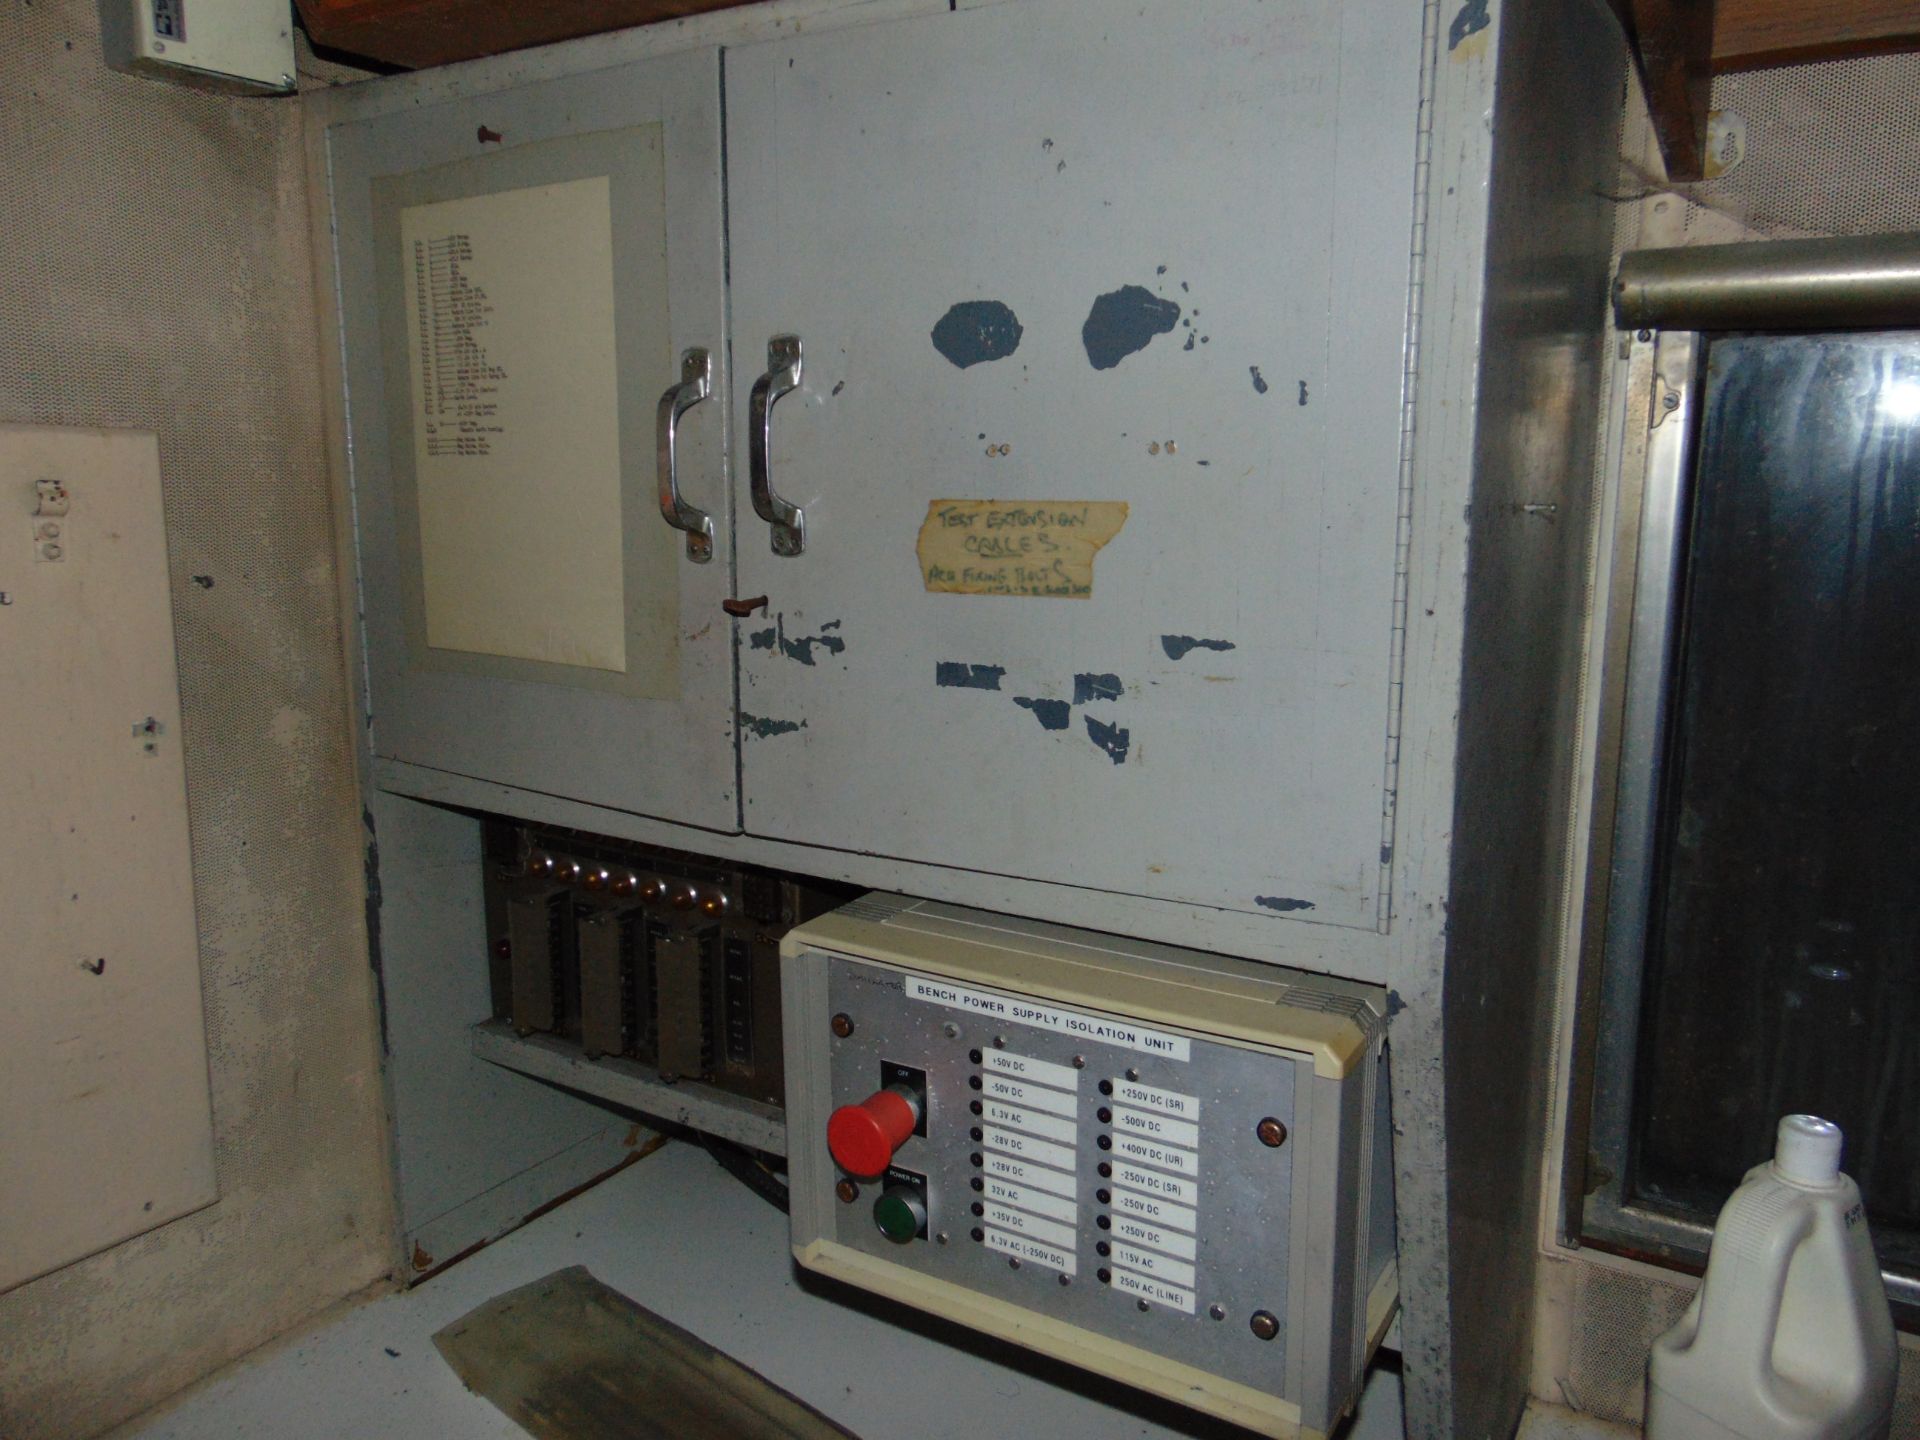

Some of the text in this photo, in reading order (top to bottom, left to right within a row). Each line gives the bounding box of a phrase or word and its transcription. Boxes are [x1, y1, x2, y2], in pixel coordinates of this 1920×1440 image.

[938, 507, 1088, 529] TEST EXTENSION
[918, 984, 1174, 1052] BENCH POWER SUPPLY ISOLATION UNIT
[993, 1058, 1024, 1071] +50V DC
[992, 1084, 1023, 1097] -50V DC
[1122, 1088, 1183, 1111] +250V DC (SR)
[991, 1108, 1022, 1123] 6.3V AC
[1121, 1117, 1160, 1131] -500V DC
[992, 1136, 1022, 1149] -28V DC
[1121, 1143, 1183, 1167] +400V DC (UR)
[992, 1162, 1023, 1176] +28V DC
[911, 1176, 921, 1185] ON
[1121, 1172, 1181, 1196] -250V DC (SR)
[991, 1186, 1018, 1200] 32V AC
[1121, 1199, 1159, 1215] -250V DC
[992, 1211, 1023, 1226] +35V DC
[1120, 1225, 1159, 1242] +250V DC
[991, 1235, 1065, 1266] 6.3V AC (-250V DC)
[1120, 1251, 1153, 1268] 115V AC
[1120, 1276, 1183, 1305] 250V AC (LINE)
